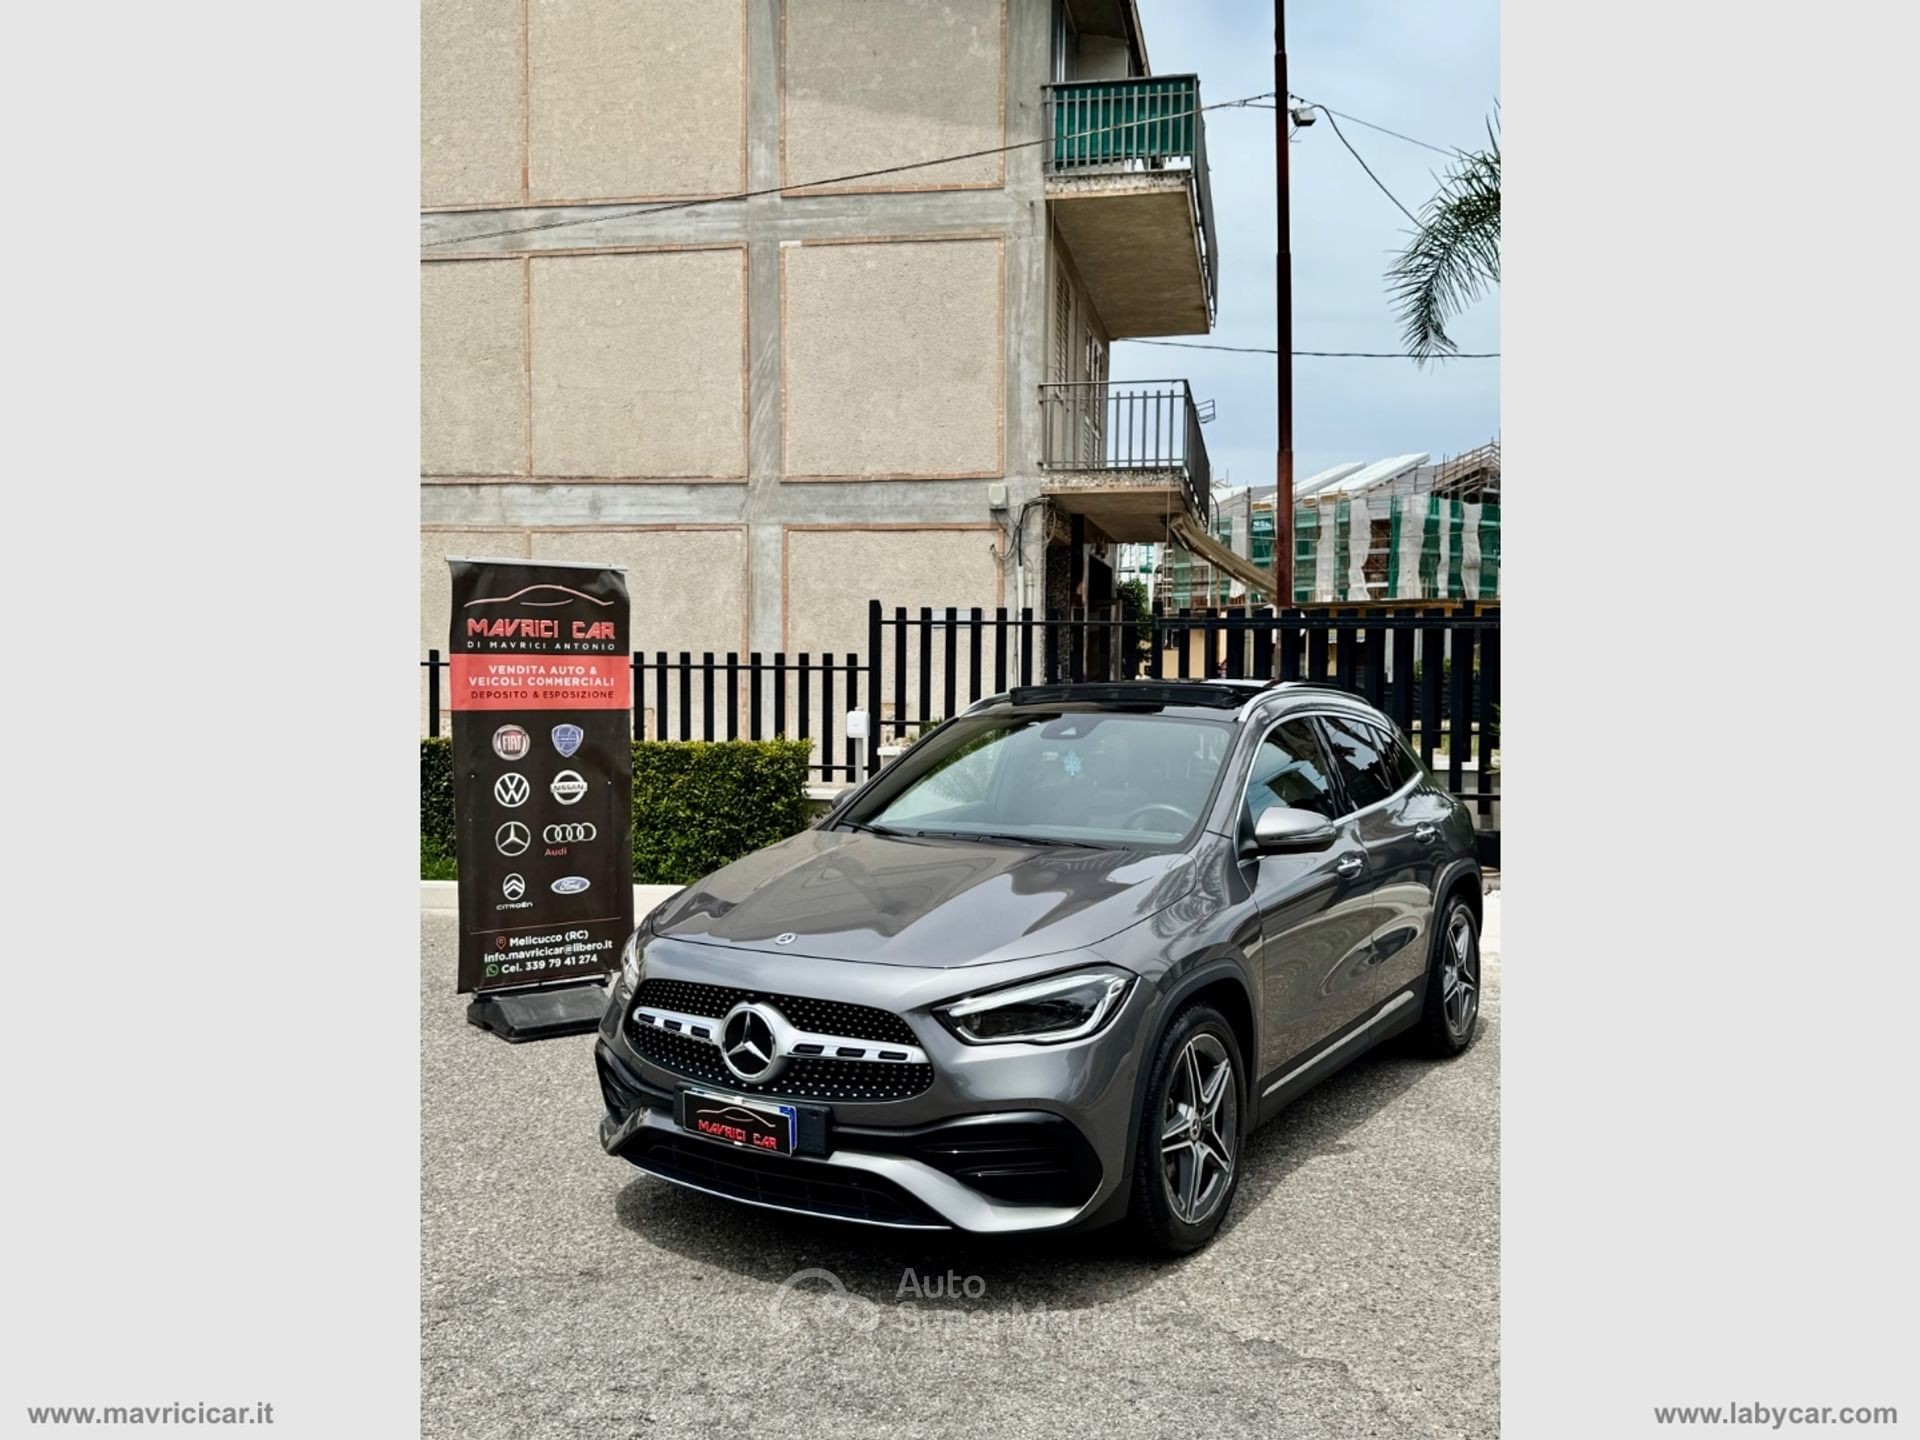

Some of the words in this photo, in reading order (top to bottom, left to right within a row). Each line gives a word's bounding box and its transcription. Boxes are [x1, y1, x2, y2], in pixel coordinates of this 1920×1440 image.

[467, 618, 559, 639] MAVRICI
[572, 621, 615, 640] CAR
[467, 641, 481, 649] DI
[489, 641, 547, 650] MAVRICI
[554, 642, 615, 651] ANTONIO
[488, 665, 545, 675] VENDITA
[549, 666, 585, 675] AUTO
[589, 666, 597, 675] &
[469, 677, 523, 687] VEICOLI
[527, 677, 615, 687] COMMERCIALI
[471, 690, 528, 699] DEPOSITO
[532, 690, 540, 699] &
[543, 690, 614, 699] ESPOSIZIONE
[502, 735, 522, 751] FIAT
[553, 783, 584, 792] NISSAN
[544, 847, 567, 857] Audi
[509, 933, 563, 947] Melicucco
[565, 929, 589, 943] (RC)
[501, 962, 523, 974] Cel.
[525, 960, 546, 971] 339
[548, 958, 562, 968] 79
[564, 956, 577, 966] 41
[578, 953, 598, 965] 274
[698, 1119, 746, 1142] MAVRICI
[753, 1133, 778, 1149] CAR
